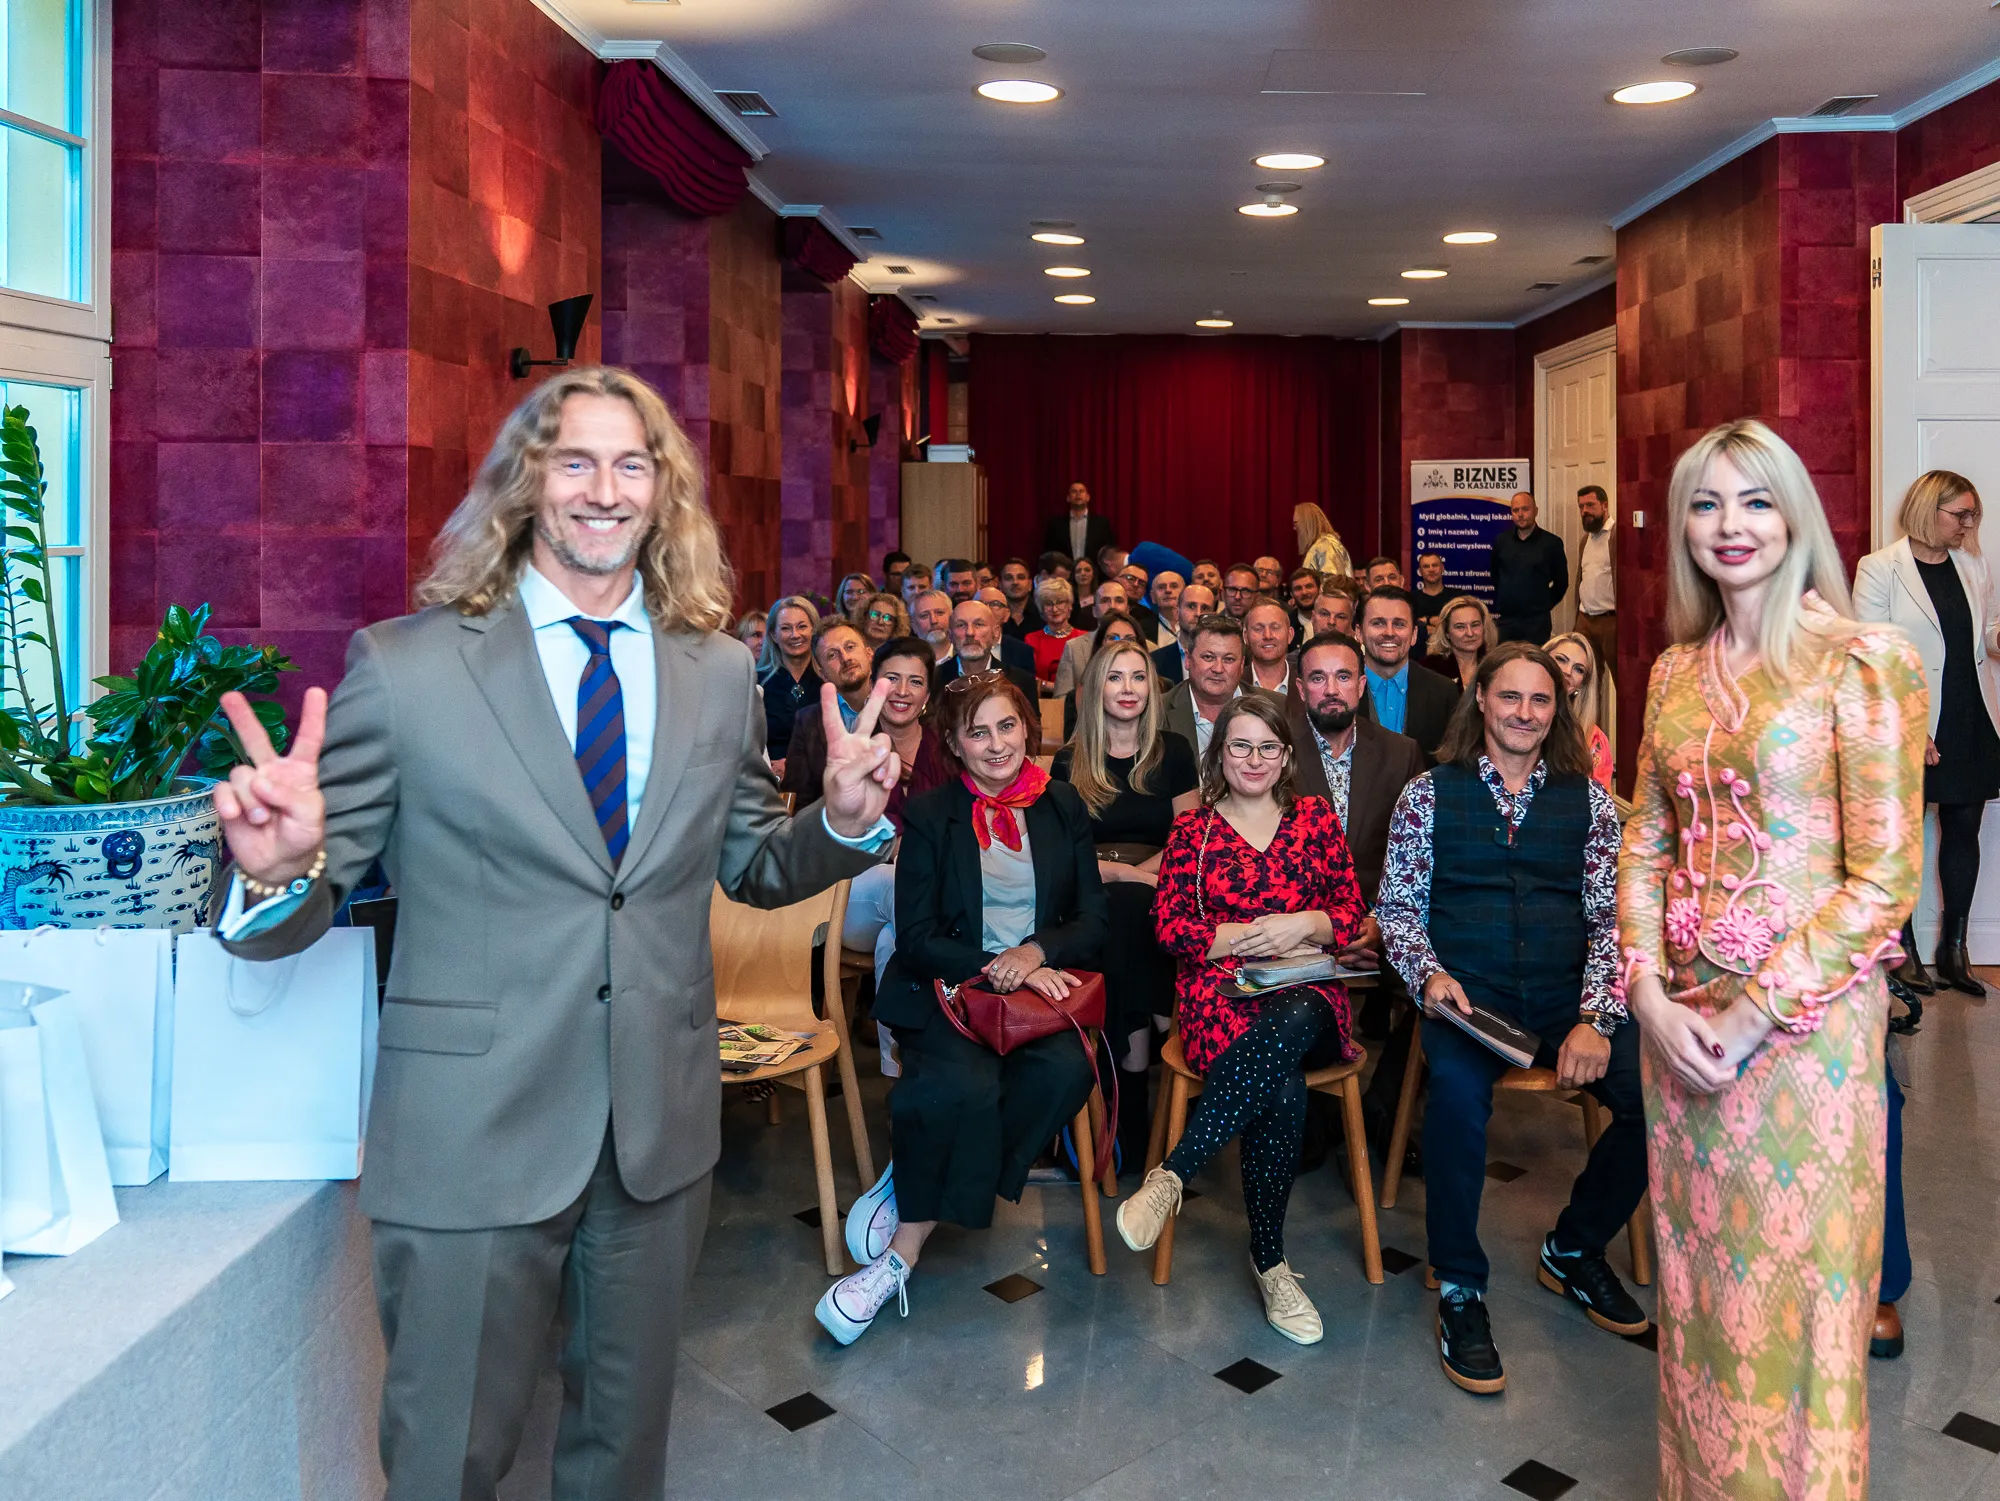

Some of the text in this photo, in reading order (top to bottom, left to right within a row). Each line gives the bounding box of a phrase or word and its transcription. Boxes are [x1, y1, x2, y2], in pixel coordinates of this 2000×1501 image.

[1454, 467, 1517, 482] BIZNES
[1419, 513, 1435, 522] Myśl
[1436, 513, 1470, 522] globalnie,
[1471, 513, 1491, 522] kupuj
[1428, 528, 1443, 537] Imię
[1448, 528, 1479, 536] nazwisko
[1457, 542, 1493, 551] umysłowe,
[1473, 584, 1495, 592] innym
